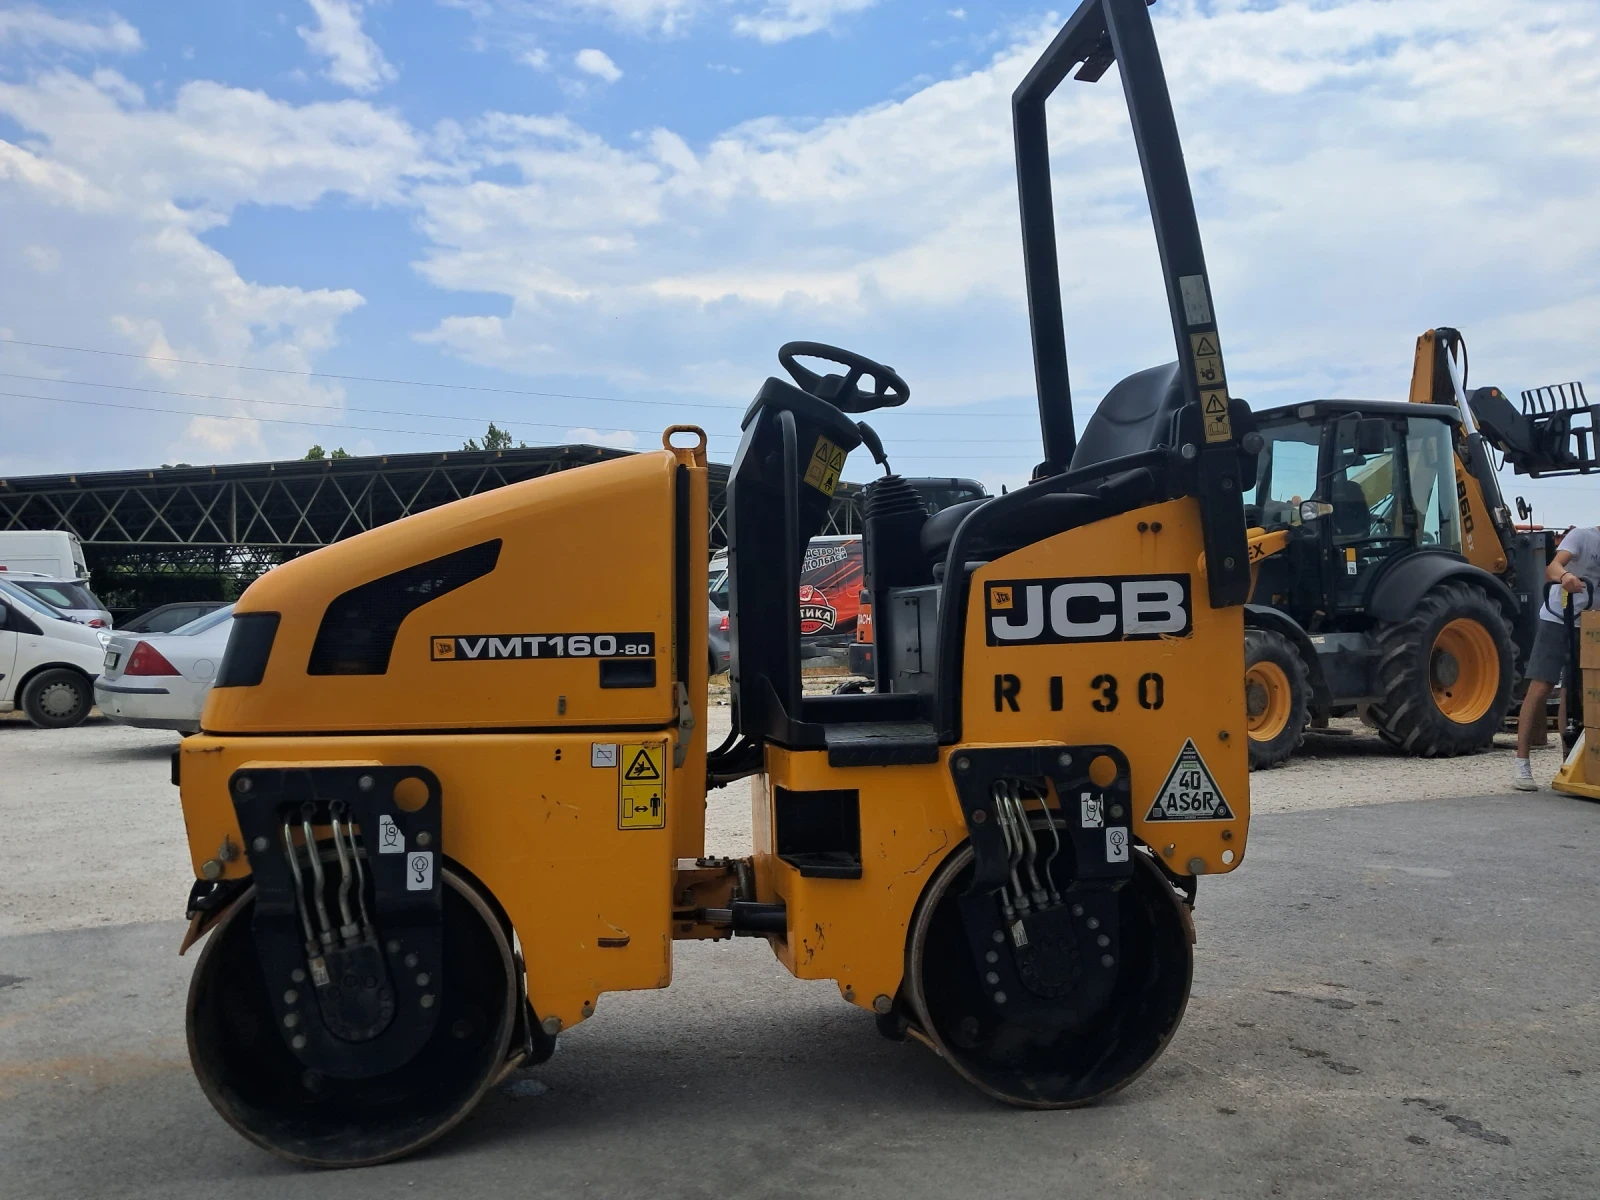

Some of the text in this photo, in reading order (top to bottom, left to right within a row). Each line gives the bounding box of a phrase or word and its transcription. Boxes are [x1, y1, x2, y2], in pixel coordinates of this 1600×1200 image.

[805, 548, 833, 559] ДСТВО
[805, 552, 848, 571] КОЛБАСИ
[800, 608, 831, 621] ТИКА
[991, 580, 1187, 640] JCB
[1166, 791, 1215, 812] AS6R
